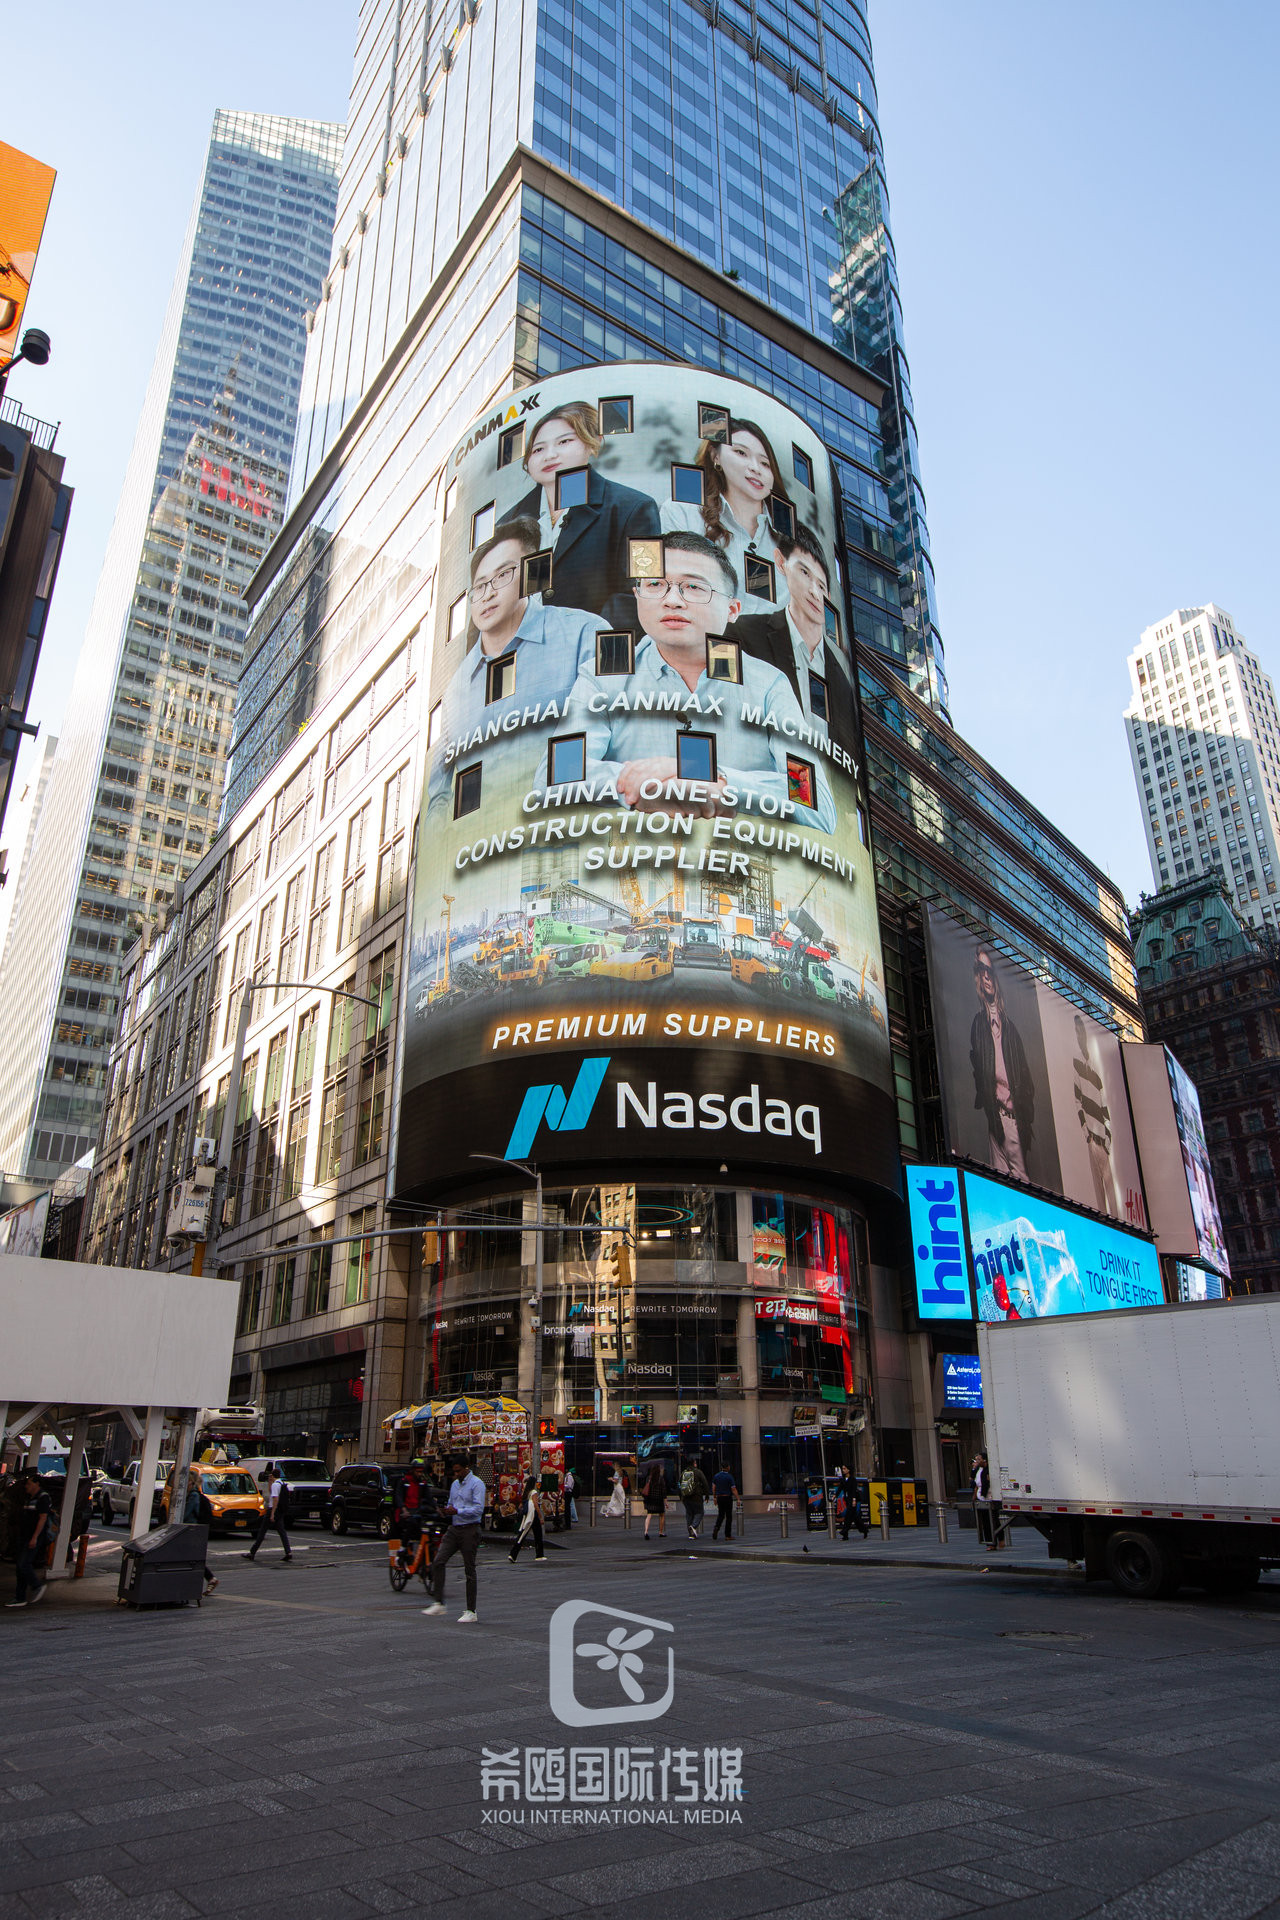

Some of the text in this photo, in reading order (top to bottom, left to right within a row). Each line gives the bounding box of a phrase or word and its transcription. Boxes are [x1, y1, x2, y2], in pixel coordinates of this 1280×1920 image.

[444, 690, 860, 780] SHANGHAI CANMAX MACHINERY
[522, 777, 796, 819] CHINA ONE-STOP
[455, 811, 856, 882] CONSTRUCTION EQUIPMENT
[584, 845, 750, 875] SUPPLIER
[492, 1013, 836, 1056] PREMIUM SUPPLIERS
[616, 1081, 823, 1155] Nasdaq
[916, 1179, 966, 1304] hint
[1099, 1249, 1142, 1282] DRINK IT
[1086, 1270, 1132, 1303] TONGUE
[477, 1312, 512, 1322] TOMORROW
[583, 1305, 615, 1313] Nasdaq
[544, 1325, 585, 1335] branded
[628, 1363, 672, 1376] Nasdaq
